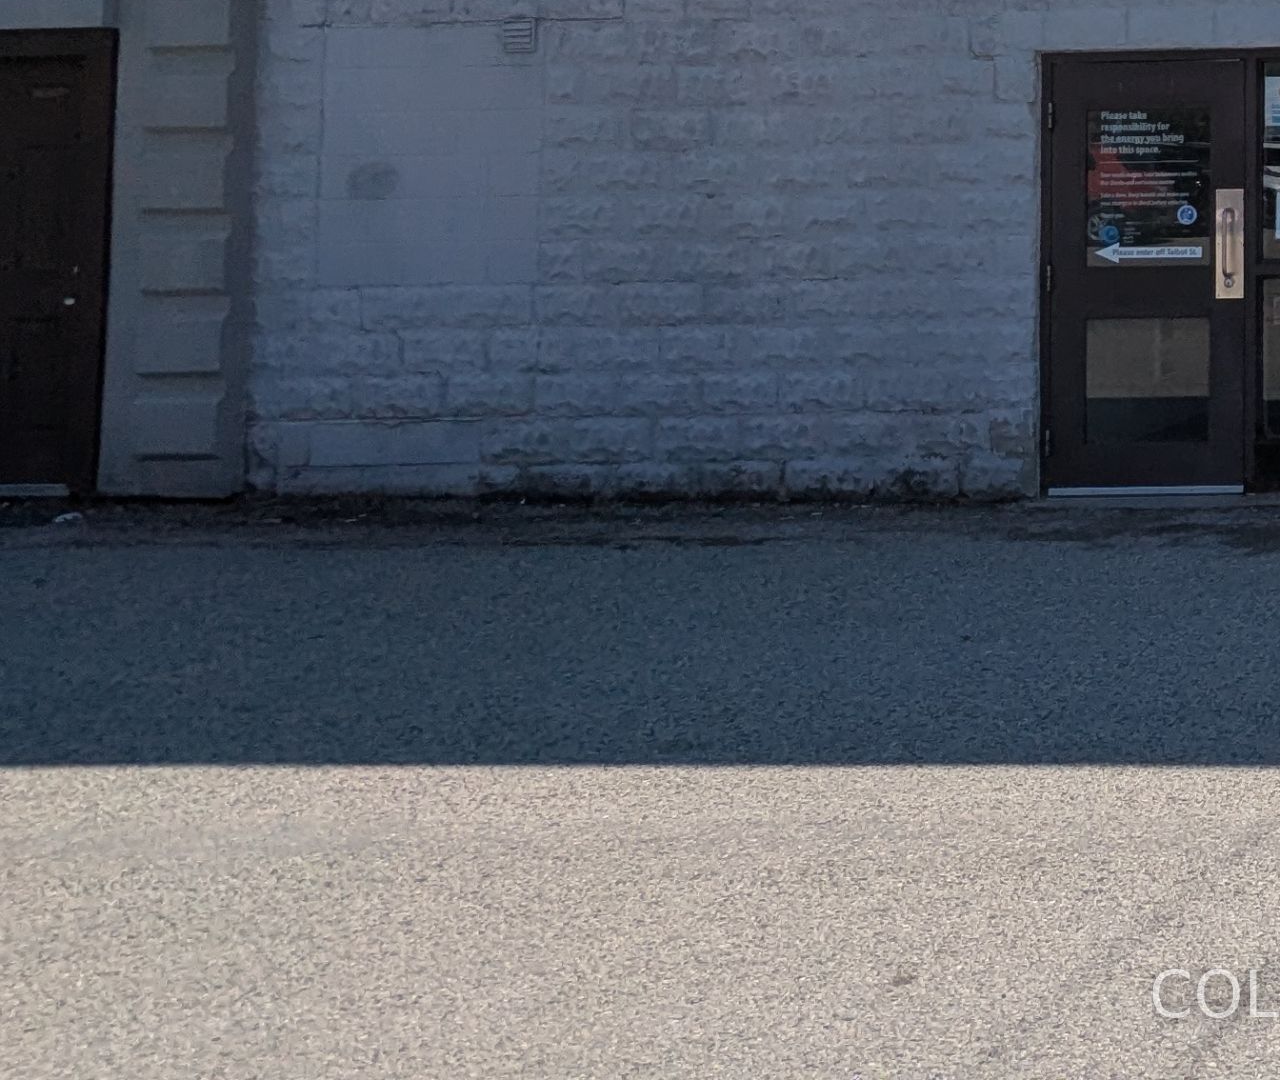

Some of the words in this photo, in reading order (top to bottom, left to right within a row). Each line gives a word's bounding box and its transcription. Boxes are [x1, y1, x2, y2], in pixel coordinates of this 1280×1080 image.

[1100, 111, 1127, 120] Please
[1128, 110, 1148, 120] take
[1100, 122, 1156, 133] responsibility
[1157, 121, 1170, 131] for
[1100, 134, 1114, 144] the
[1115, 135, 1144, 145] energy
[1145, 135, 1161, 144] you
[1162, 133, 1185, 144] bring
[1100, 145, 1118, 155] into
[1118, 145, 1135, 154] this
[1135, 146, 1162, 157] space.
